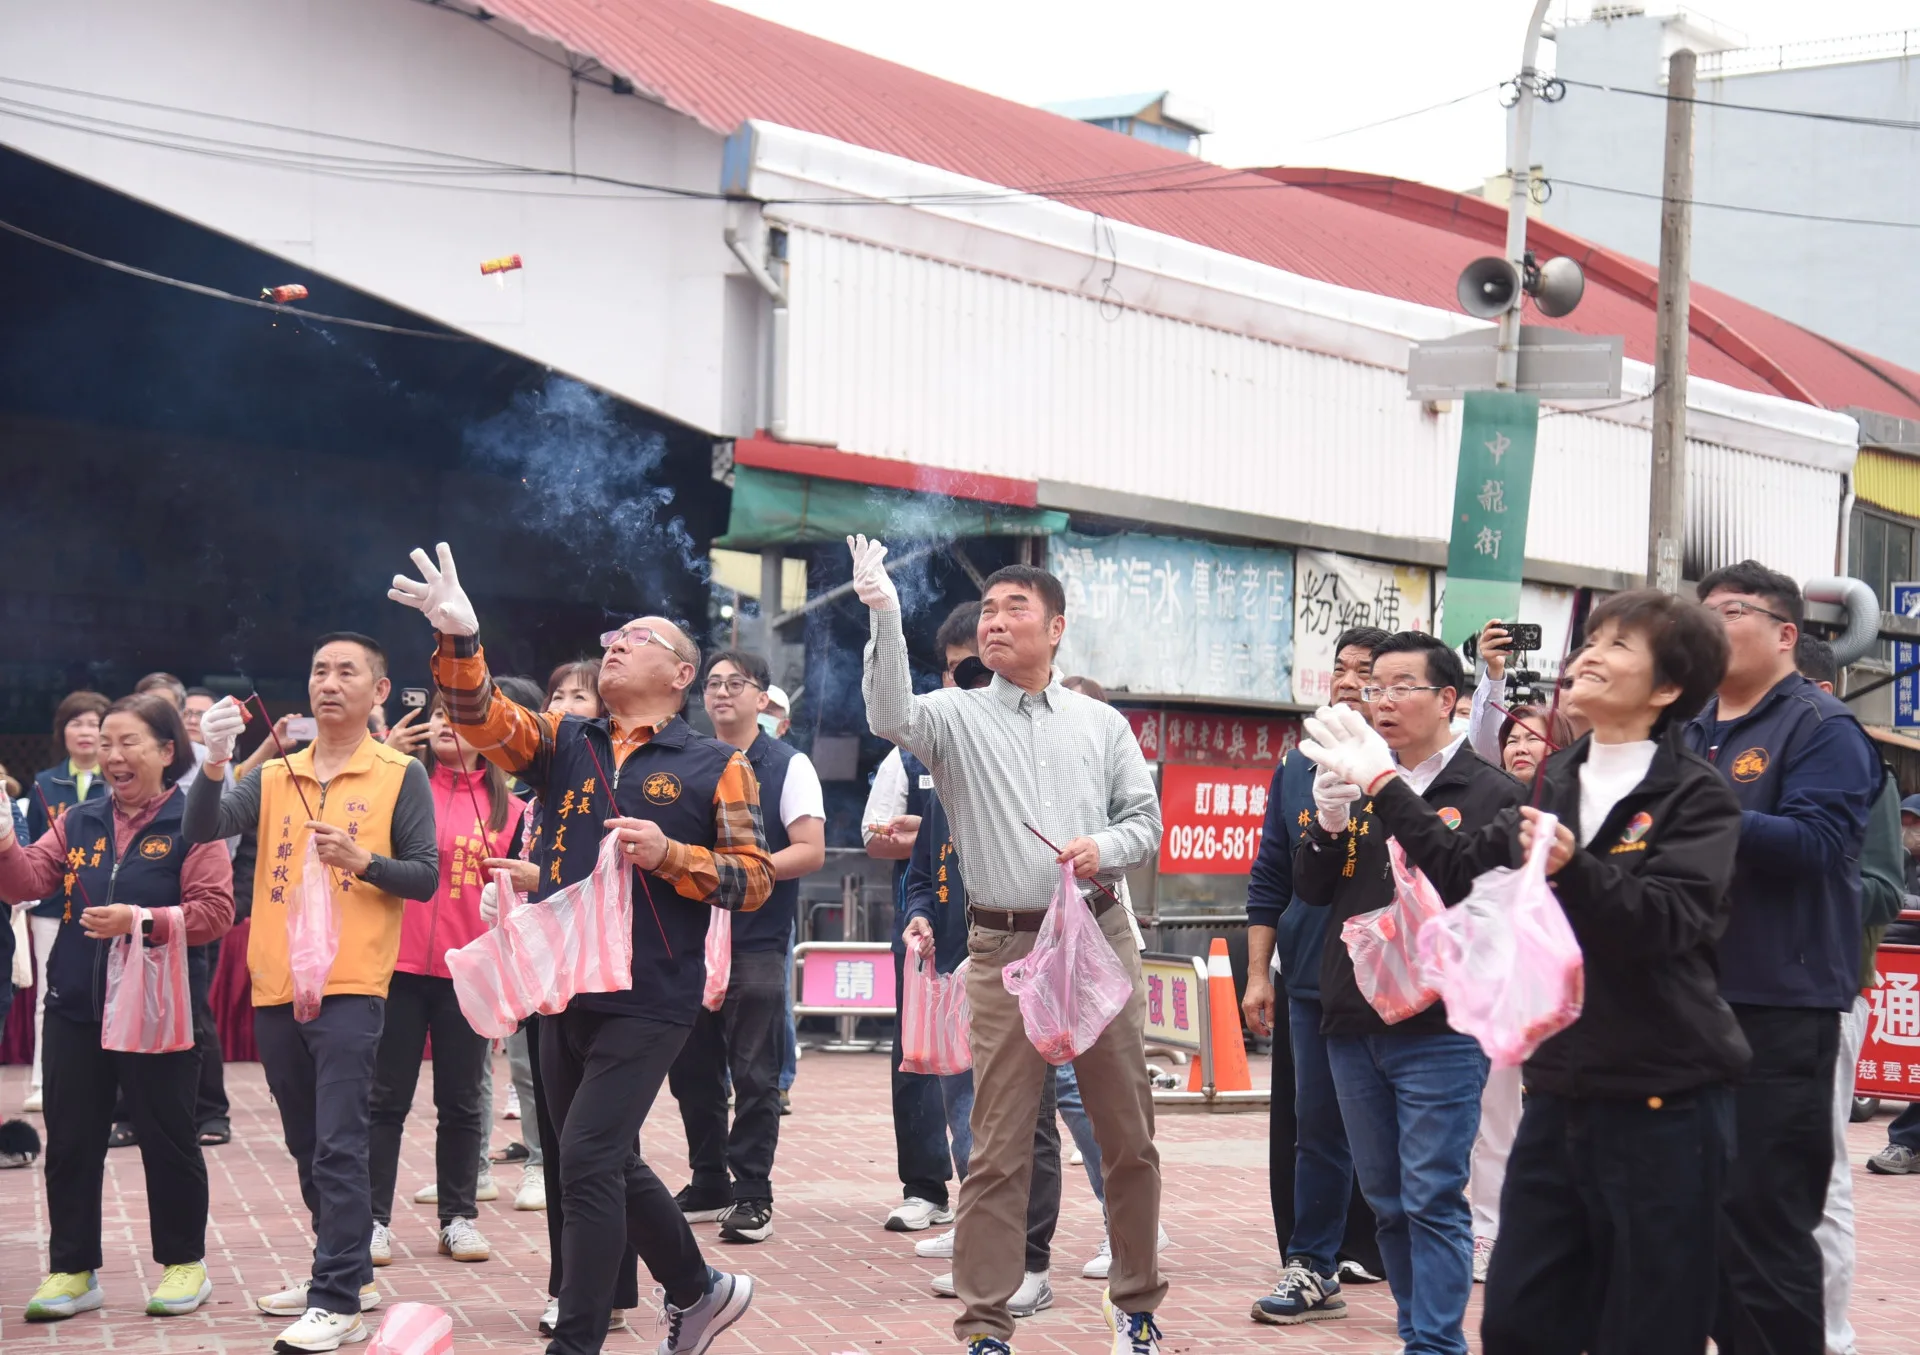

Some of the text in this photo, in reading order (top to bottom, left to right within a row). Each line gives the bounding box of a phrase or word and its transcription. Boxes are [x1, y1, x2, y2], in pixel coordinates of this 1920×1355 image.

[1473, 430, 1511, 560] 中龍街
[576, 778, 597, 815] 議長
[270, 842, 293, 904] 鄭秋風
[835, 960, 875, 1000] 請
[1870, 969, 1920, 1047] 通
[1857, 1058, 1920, 1084] 慈雲宮
